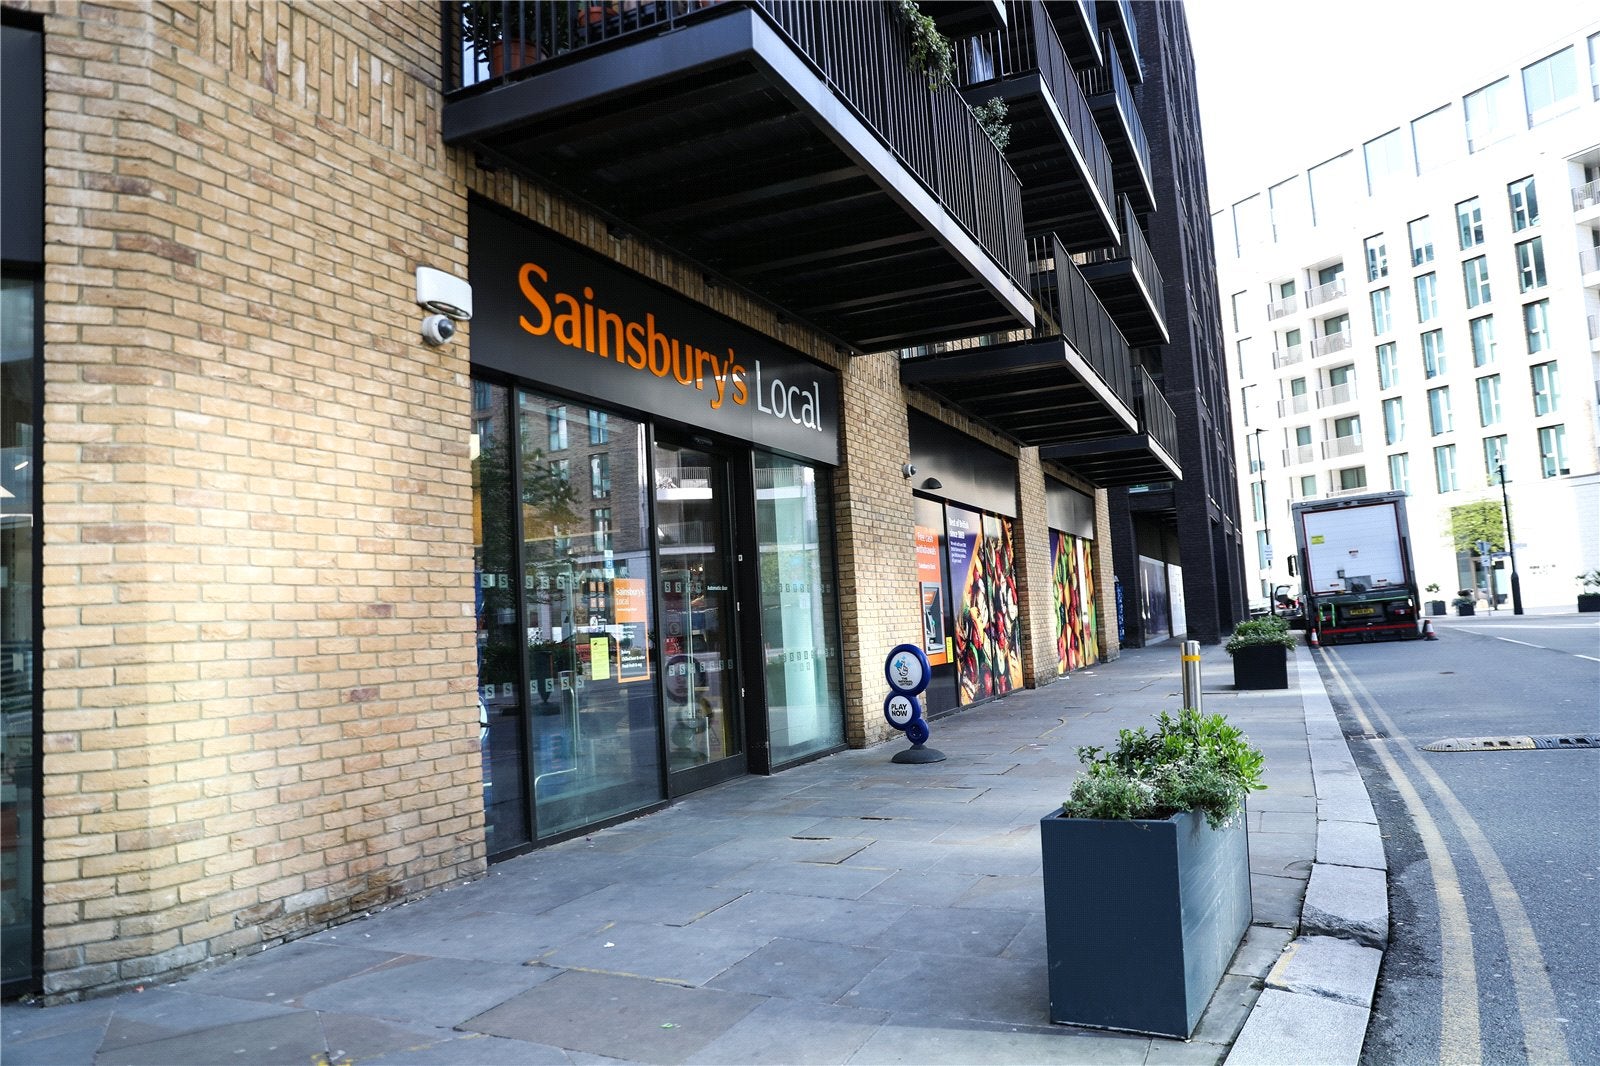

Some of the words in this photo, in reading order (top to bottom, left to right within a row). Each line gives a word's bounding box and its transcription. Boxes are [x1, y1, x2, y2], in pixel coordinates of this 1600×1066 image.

[518, 263, 748, 410] Sainsbury's
[755, 360, 822, 432] Local
[500, 575, 508, 587] S
[616, 587, 645, 597] Sainsbury's
[486, 685, 494, 697] S
[504, 684, 511, 695] S
[531, 681, 537, 692] S
[546, 679, 553, 691] S
[562, 677, 568, 689] S
